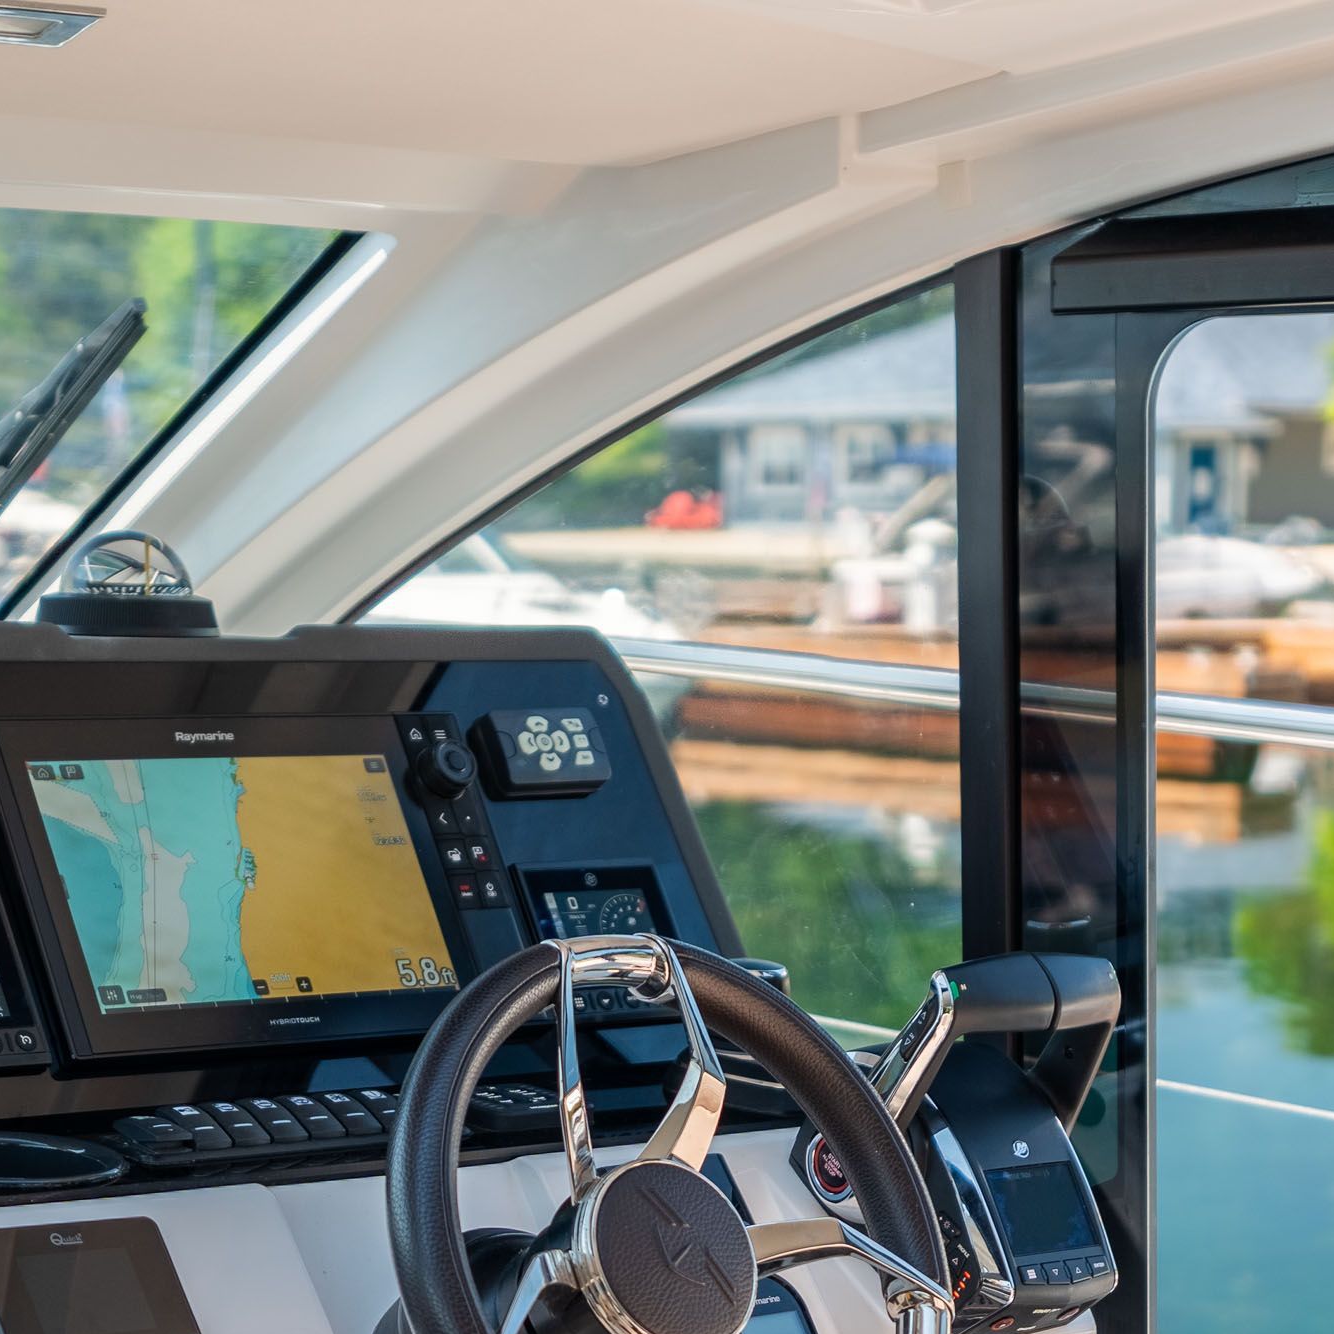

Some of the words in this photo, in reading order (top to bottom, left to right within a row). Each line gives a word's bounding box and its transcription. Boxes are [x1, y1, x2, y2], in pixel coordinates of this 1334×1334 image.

[174, 731, 235, 744] Raymarine
[395, 957, 441, 987] 5.8
[440, 966, 457, 985] ft
[269, 1016, 321, 1026] HYBRIDTOUCH
[49, 1231, 83, 1247] Quick
[755, 1295, 781, 1305] marine
